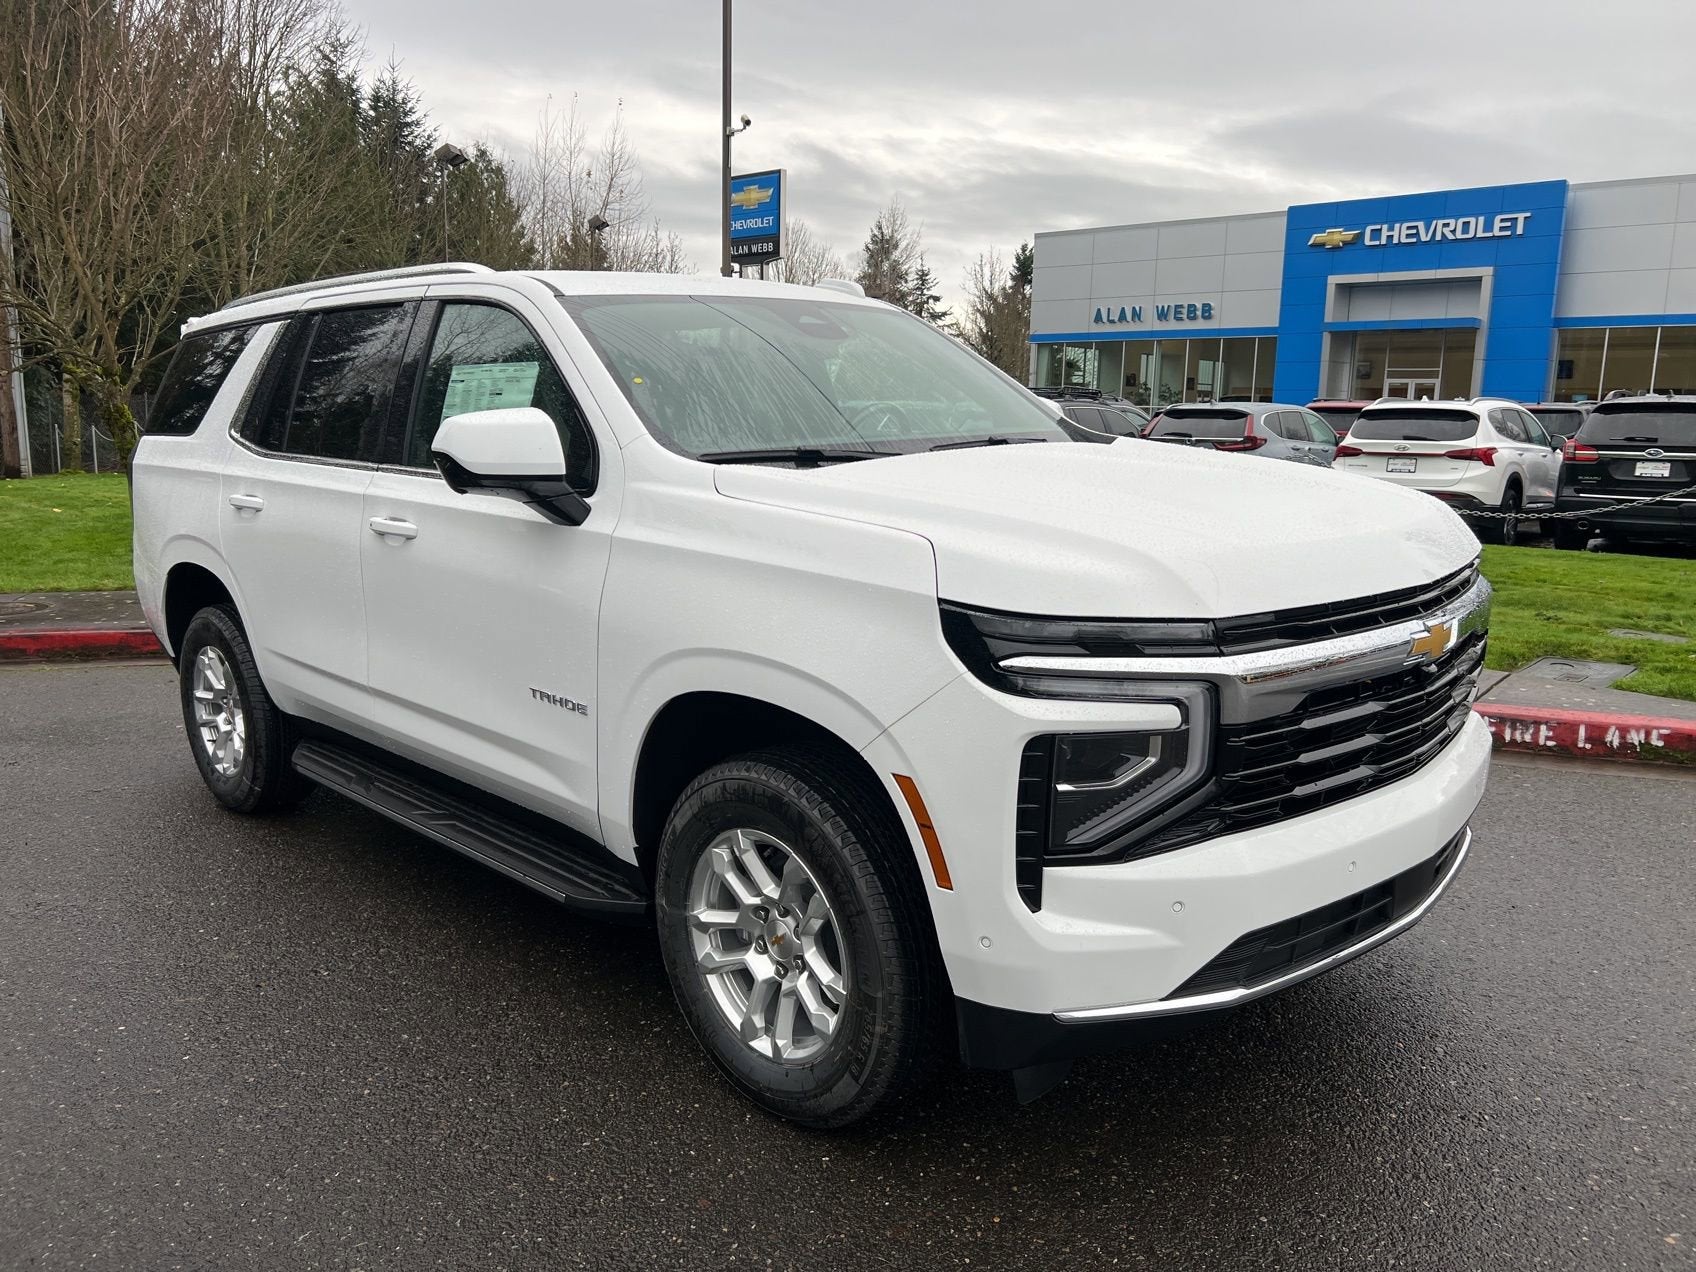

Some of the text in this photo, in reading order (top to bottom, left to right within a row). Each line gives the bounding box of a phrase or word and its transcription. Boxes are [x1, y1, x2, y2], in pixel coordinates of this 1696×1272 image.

[1364, 212, 1531, 246] CHEVROLET
[751, 242, 773, 252] WEBB
[1093, 302, 1213, 324] ALAN WEBB
[529, 686, 588, 716] TAHOE
